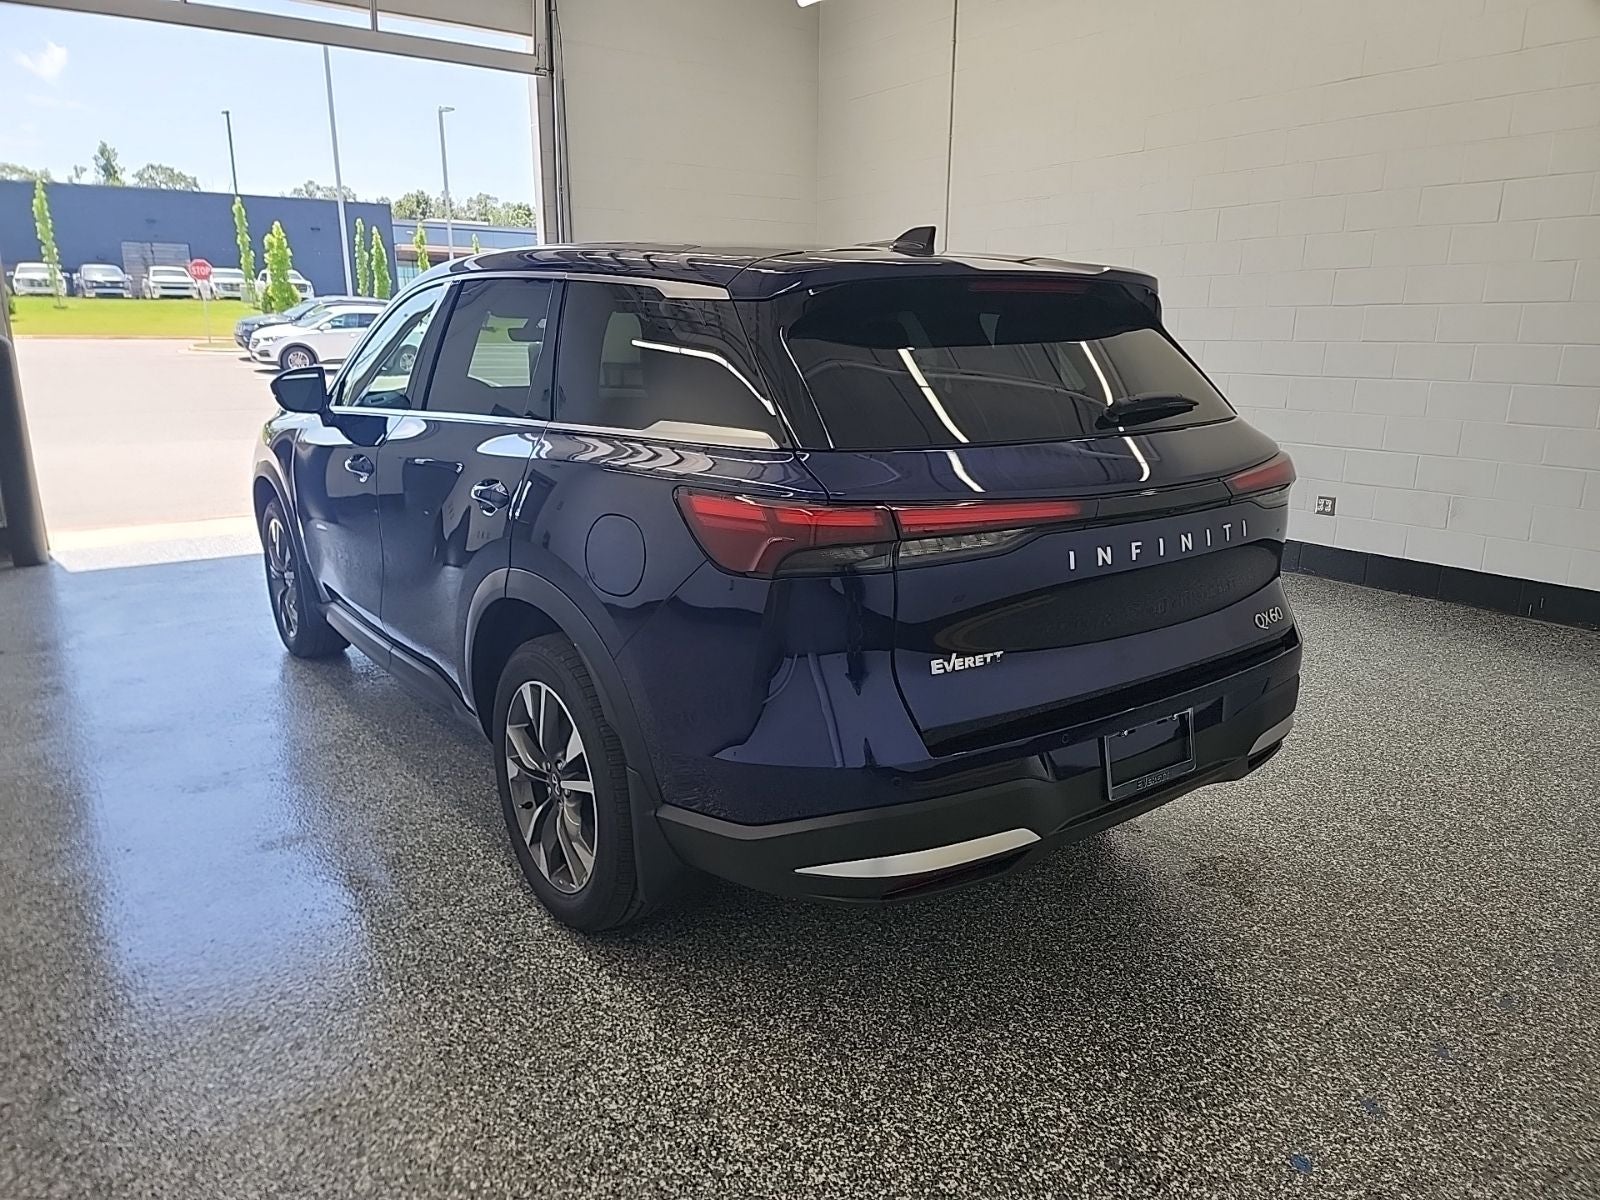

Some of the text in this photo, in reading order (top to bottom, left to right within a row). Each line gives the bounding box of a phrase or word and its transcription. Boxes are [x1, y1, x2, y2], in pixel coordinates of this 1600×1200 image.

[191, 265, 210, 276] STOP
[1068, 519, 1248, 570] INFINITI
[1254, 606, 1283, 629] QX60
[930, 650, 1004, 675] EVERETT
